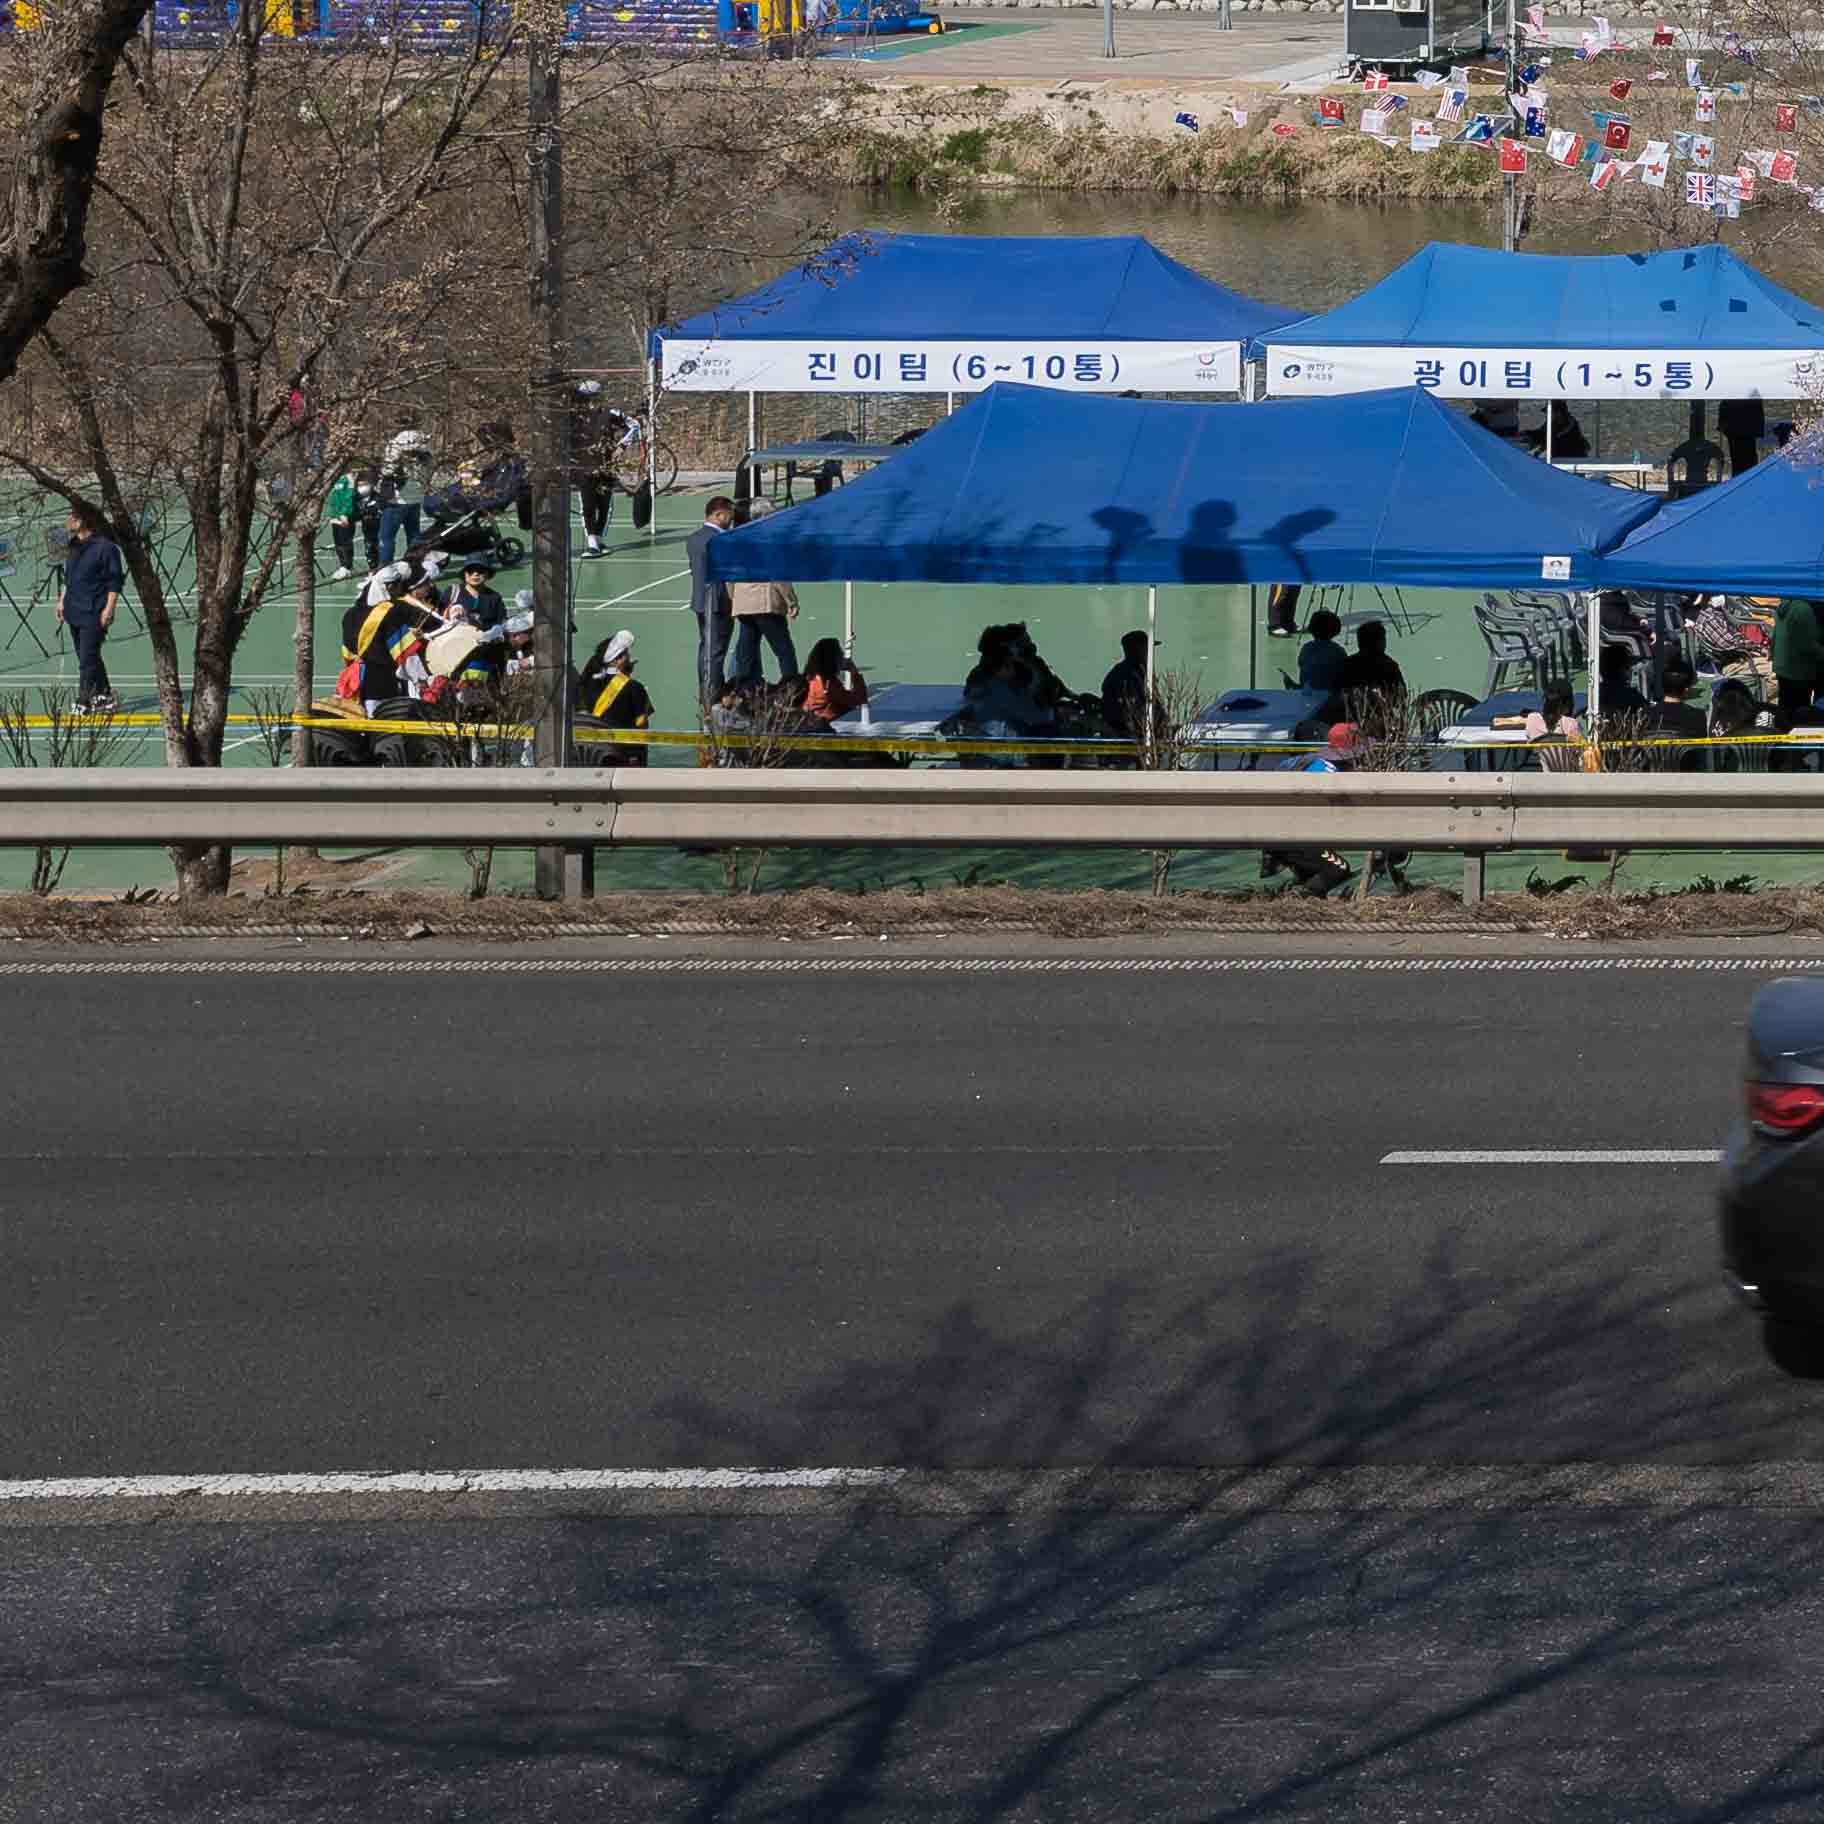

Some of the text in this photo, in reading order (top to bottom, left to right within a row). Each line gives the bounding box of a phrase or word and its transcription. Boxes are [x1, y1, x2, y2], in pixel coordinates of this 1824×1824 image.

[807, 352, 1120, 383] 진이팀 (6~10통)
[1413, 360, 1714, 390] 광이팀 (1~5통)
